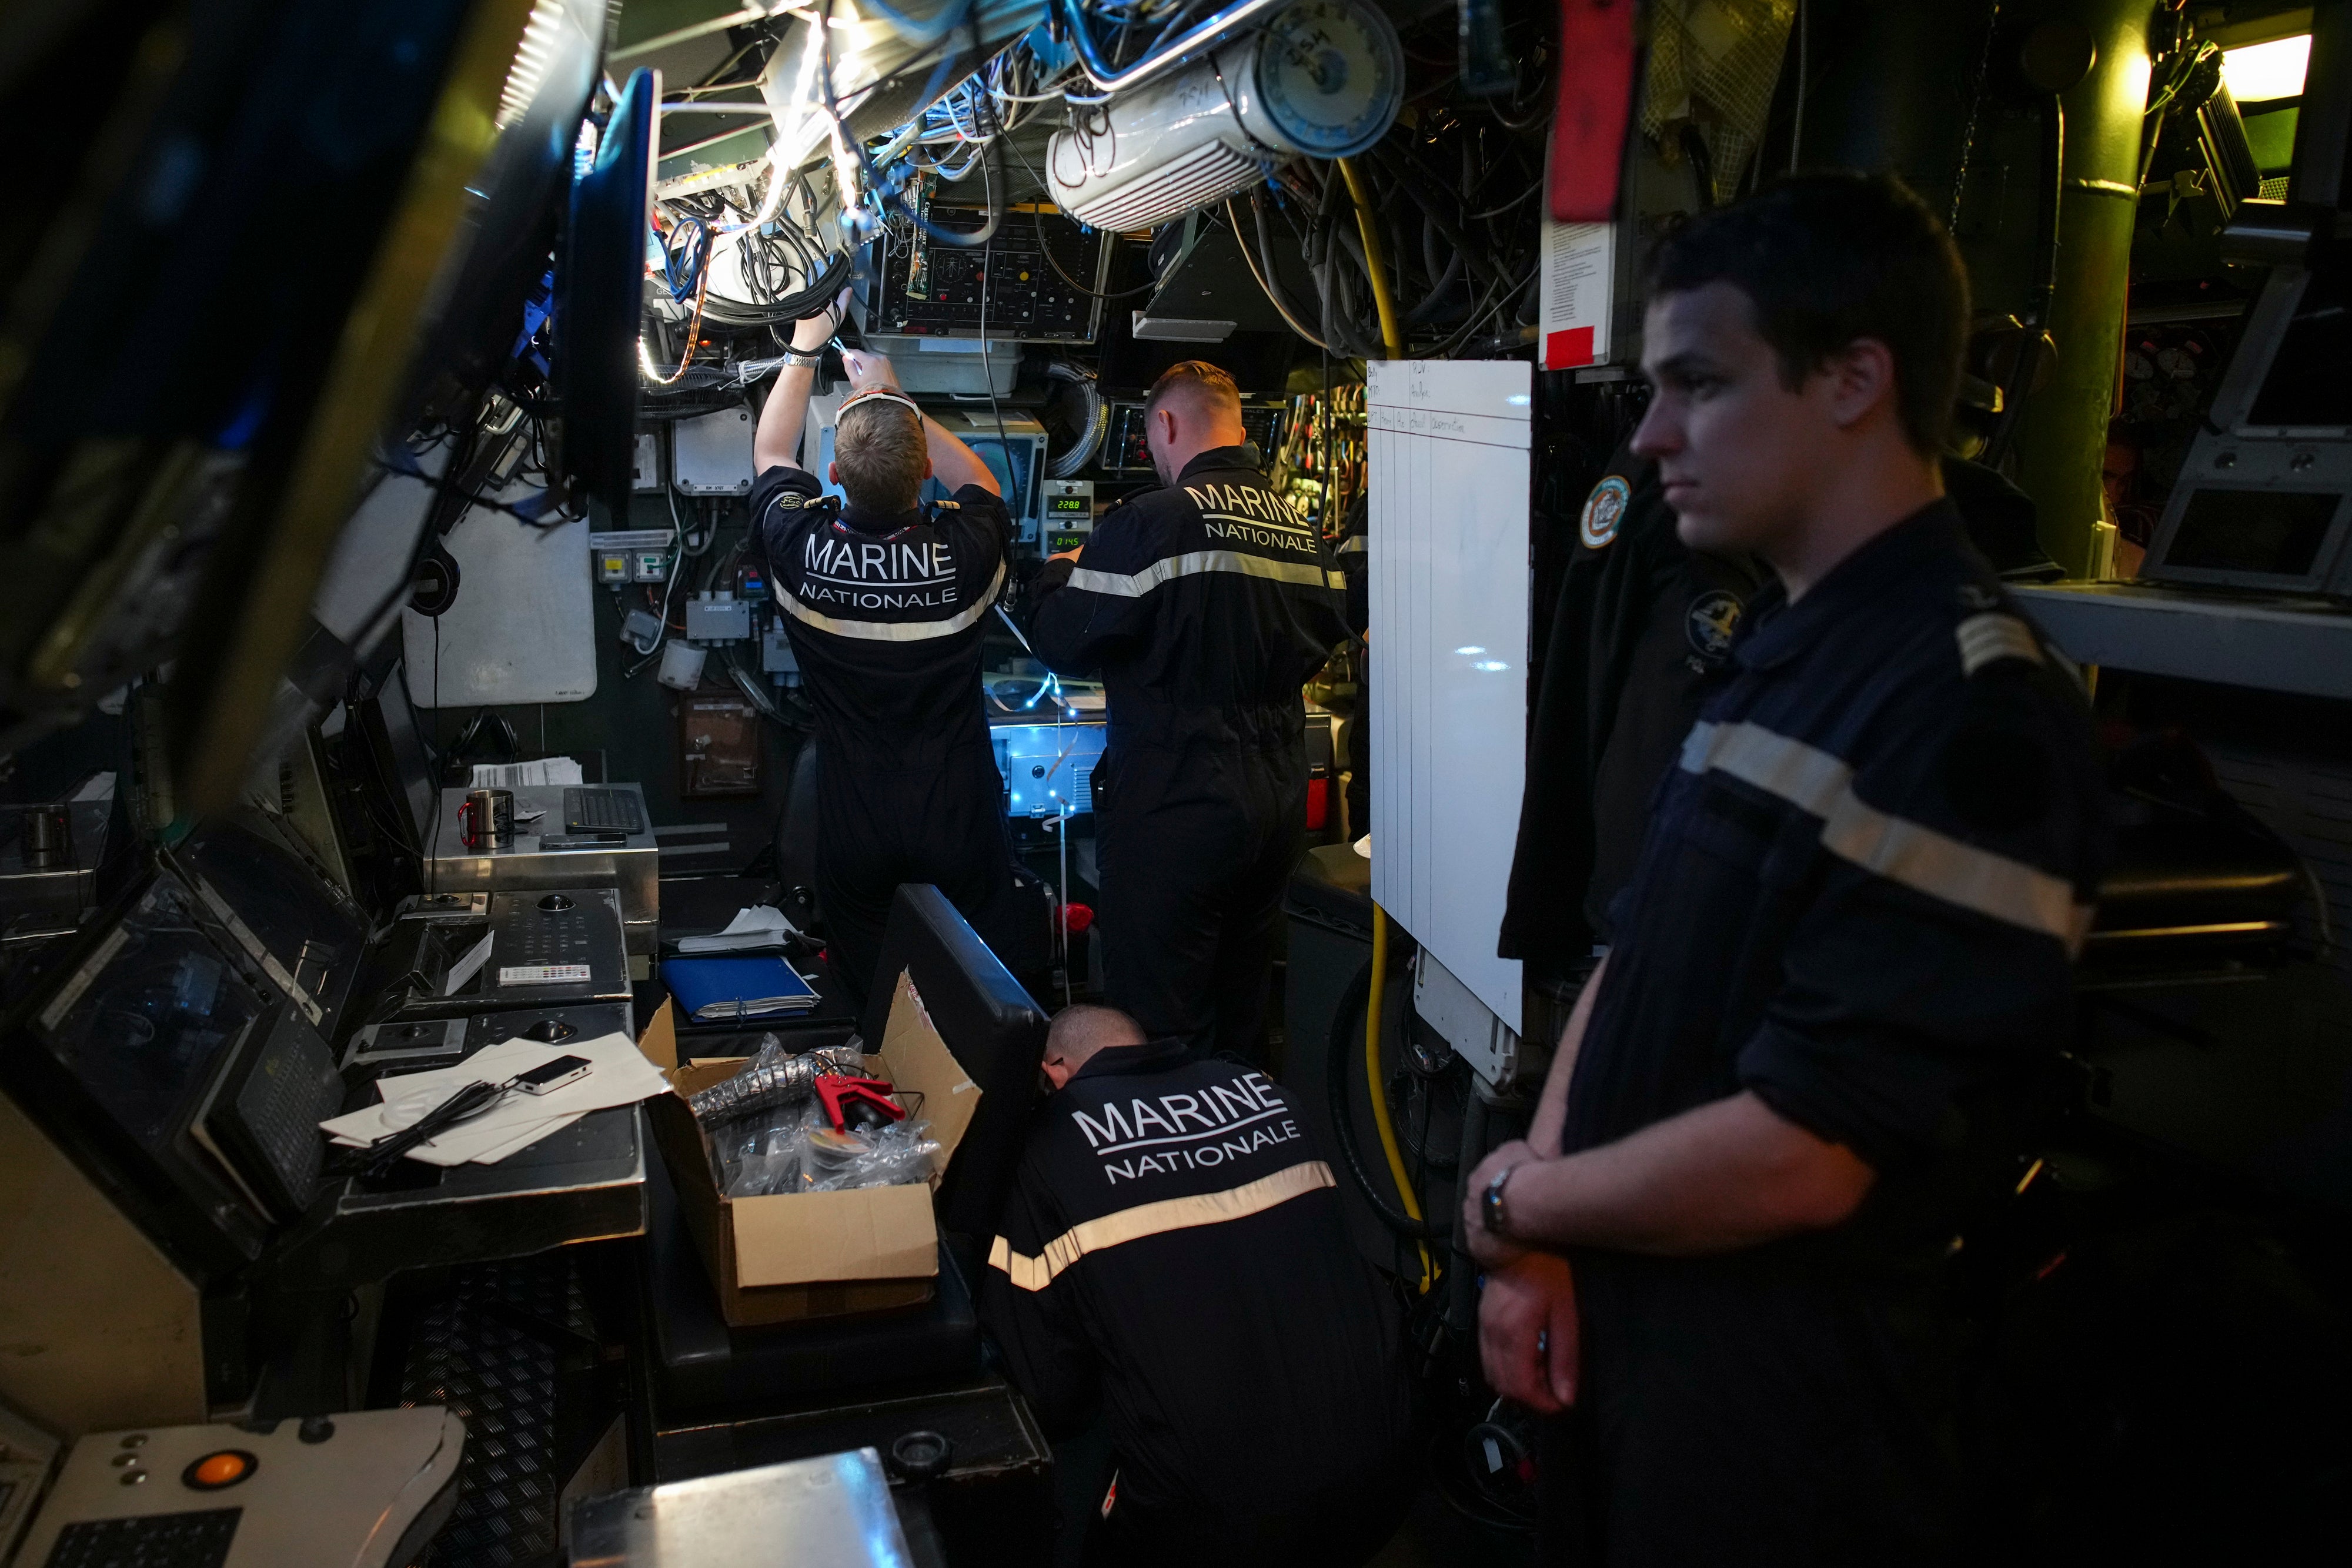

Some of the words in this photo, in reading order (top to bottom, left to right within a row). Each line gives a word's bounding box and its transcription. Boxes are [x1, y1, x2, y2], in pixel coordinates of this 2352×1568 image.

[1184, 484, 1311, 528] MARINE
[804, 533, 957, 580] MARINE
[1205, 523, 1317, 554] NATIONALE
[799, 581, 958, 609] NATIONALE
[1071, 1072, 1285, 1148] MARINE
[1104, 1119, 1301, 1185] NATIONALE
